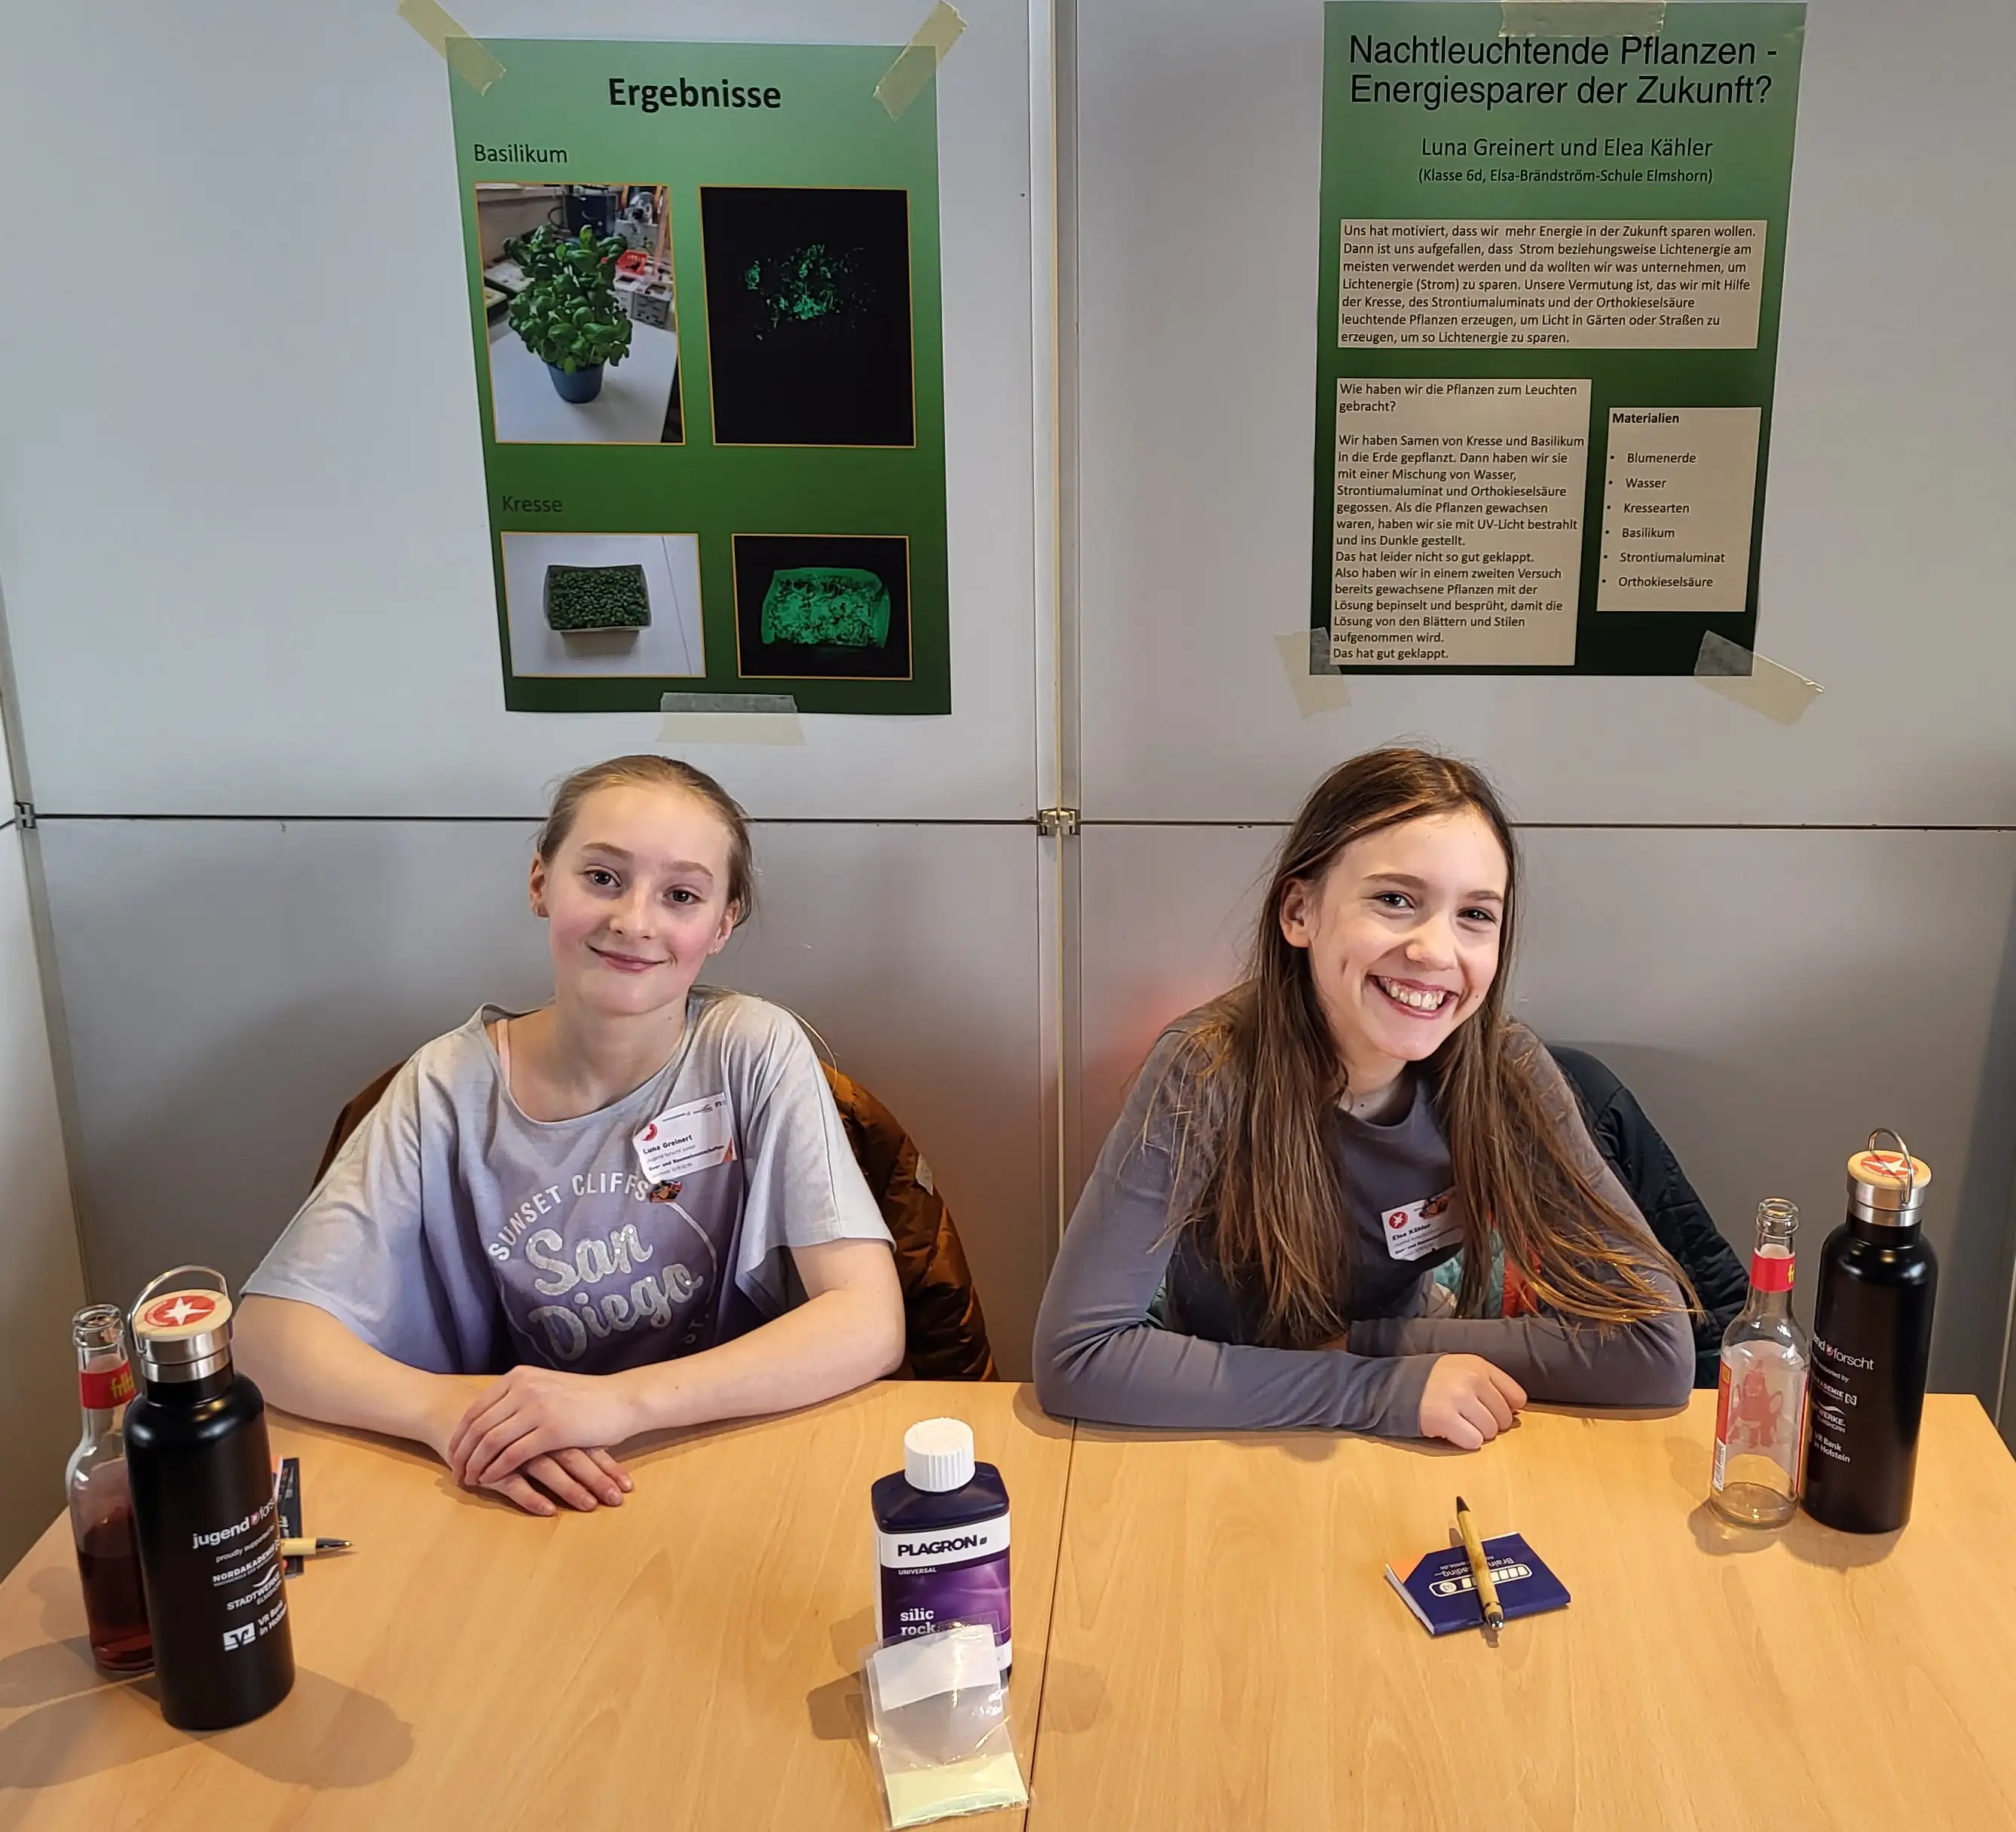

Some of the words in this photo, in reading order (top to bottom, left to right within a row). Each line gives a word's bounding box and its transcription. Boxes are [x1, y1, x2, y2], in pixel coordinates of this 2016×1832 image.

[1350, 35, 1609, 65] Nachtleuchtende
[1621, 35, 1755, 65] Pflanzen
[609, 77, 781, 113] Ergebnisse
[1351, 74, 1568, 111] Energiesparer
[1577, 75, 1628, 104] der
[1636, 75, 1772, 104] Zukunft?
[474, 143, 567, 163] Basilikum
[1422, 138, 1467, 156] Luna
[1473, 138, 1555, 157] Greinert
[1561, 137, 1598, 157] und
[1605, 137, 1644, 157] Elea
[1650, 137, 1713, 157] Kähler
[1418, 167, 1463, 184] (Klasse
[1466, 168, 1486, 184] 6d,
[1490, 168, 1643, 182] Elsa-Brändström-Schule
[1647, 168, 1712, 185] Elmshorn)
[1344, 224, 1366, 237] Uns
[1369, 224, 1389, 237] hat
[1391, 225, 1449, 238] motiviert,
[1452, 225, 1478, 237] dass
[1480, 225, 1500, 237] wir
[1505, 225, 1537, 237] mehr
[1539, 225, 1583, 240] Energie
[1586, 225, 1596, 237] in
[1599, 225, 1620, 237] der
[1622, 225, 1669, 237] Zukunft
[1671, 228, 1711, 240] sparen
[1714, 225, 1756, 237] wollen.
[1344, 243, 1374, 255] Dann
[1377, 243, 1391, 255] ist
[1394, 245, 1415, 255] uns
[1418, 242, 1485, 257] aufgefallen,
[1488, 242, 1513, 255] dass
[1519, 243, 1554, 255] Strom
[1558, 243, 1657, 257] beziehungsweise
[1660, 243, 1731, 258] Lichtenergie
[1733, 246, 1751, 255] am
[1342, 277, 1413, 292] Lichtenergie
[1416, 277, 1460, 292] (Strom)
[1462, 281, 1476, 290] zu
[1478, 281, 1521, 293] sparen.
[1525, 279, 1565, 290] Unsere
[1568, 279, 1634, 293] Vermutung
[1636, 279, 1653, 292] ist,
[1657, 279, 1677, 290] das
[1679, 279, 1699, 291] wir
[1701, 279, 1721, 291] mit
[1724, 278, 1750, 291] Hilfe
[1341, 295, 1363, 307] der
[1365, 295, 1406, 309] Kresse,
[1409, 295, 1429, 307] des
[1431, 295, 1545, 308] Strontiumaluminats
[1548, 295, 1571, 308] und
[1573, 296, 1594, 308] der
[1596, 295, 1695, 308] Orthokieselsäure
[1341, 333, 1397, 345] erzeugen,
[1400, 334, 1419, 343] um
[1421, 334, 1436, 343] so
[1439, 331, 1509, 345] Lichtenergie
[1510, 334, 1524, 343] zu
[1527, 334, 1569, 345] sparen.
[1339, 383, 1363, 394] Wie
[1366, 383, 1402, 395] haben
[1404, 384, 1424, 395] wir
[1425, 383, 1444, 395] die
[1446, 383, 1494, 395] Pflanzen
[1497, 386, 1522, 396] zum
[1525, 384, 1577, 396] Leuchten
[1338, 399, 1397, 414] gebracht?
[1612, 412, 1679, 424] Materialien
[1627, 451, 1696, 463] Blumenerde
[1338, 468, 1357, 479] mit
[1360, 468, 1390, 479] einer
[1392, 468, 1447, 482] Mischung
[1449, 471, 1470, 480] von
[1473, 469, 1516, 482] Wasser,
[1625, 477, 1667, 488] Wasser
[1337, 485, 1443, 497] Strontiumaluminat
[1446, 485, 1468, 497] und
[1470, 485, 1567, 497] Orthokieselsäure
[502, 495, 563, 512] Kresse
[1623, 503, 1690, 514] Kressearten
[1622, 527, 1675, 538] Basilikum
[1336, 534, 1358, 546] und
[1360, 534, 1377, 546] ins
[1379, 534, 1419, 546] Dunkle
[1421, 535, 1465, 548] gestellt.
[1620, 552, 1725, 563] Strontiumaluminat
[1618, 576, 1713, 587] Orthokieselsäure
[1335, 583, 1374, 595] bereits
[1375, 583, 1445, 597] gewachsene
[1447, 583, 1494, 595] Pflanzen
[1497, 584, 1516, 595] mit
[1519, 583, 1538, 595] der
[1334, 600, 1374, 613] Lösung
[1376, 599, 1428, 613] bepinselt
[1430, 599, 1452, 610] und
[1455, 599, 1508, 613] besprüht,
[1510, 600, 1543, 611] damit
[1546, 600, 1563, 611] die
[1332, 632, 1414, 644] aufgenommen
[1416, 632, 1444, 643] wird.
[1333, 648, 1354, 659] Das
[1356, 647, 1375, 659] hat
[1376, 648, 1396, 661] gut
[1397, 647, 1449, 661] geklappt.
[642, 1145, 661, 1155] Luna
[662, 1134, 693, 1148] Greinert
[488, 1185, 562, 1262] SUNSET
[571, 1172, 650, 1201] CLIFFS
[525, 1223, 654, 1296] San
[528, 1263, 704, 1362] Diego
[1833, 1347, 1874, 1370] forscht
[1823, 1437, 1843, 1452] Bank
[1820, 1445, 1851, 1463] Holstein
[192, 1516, 251, 1549] jugend
[898, 1534, 977, 1557] PLAGRON
[898, 1567, 938, 1576] UNIVERSAL
[900, 1607, 935, 1622] silic
[900, 1622, 936, 1637] rock
